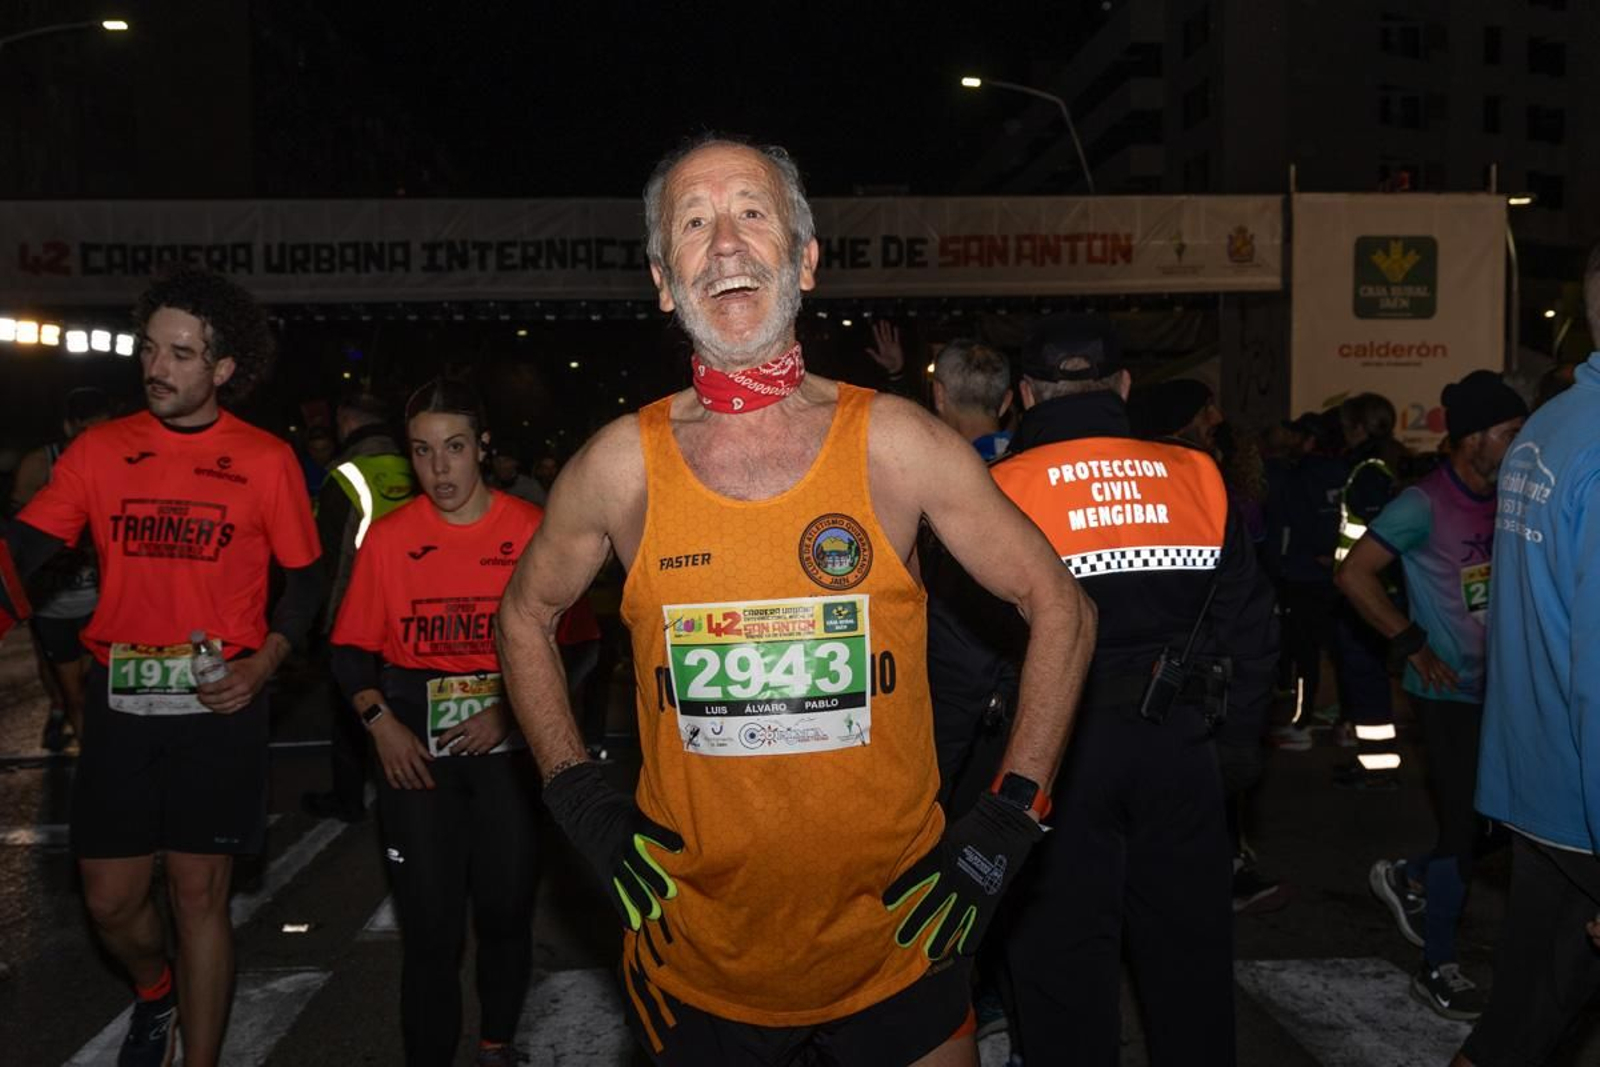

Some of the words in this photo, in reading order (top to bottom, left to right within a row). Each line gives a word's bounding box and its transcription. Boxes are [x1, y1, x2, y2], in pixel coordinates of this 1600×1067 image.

[19, 241, 71, 275] 42
[81, 241, 253, 276] CARRERA
[265, 241, 410, 274] URBANA
[421, 237, 649, 273] INTERNACI
[818, 235, 871, 269] HE
[881, 235, 929, 269] DE
[938, 234, 1010, 268] SAN
[1013, 232, 1133, 267] ANTON
[1337, 340, 1449, 359] calderón
[1047, 459, 1168, 486] PROTECCION
[1091, 481, 1142, 503] CIVIL
[1068, 503, 1171, 531] MENGIBAR
[659, 553, 712, 571] FASTER
[707, 611, 743, 638] 42
[683, 641, 853, 700] 2943
[705, 706, 729, 716] LUIS
[744, 701, 788, 715] ÁLVARO
[804, 697, 840, 711] PABLO
